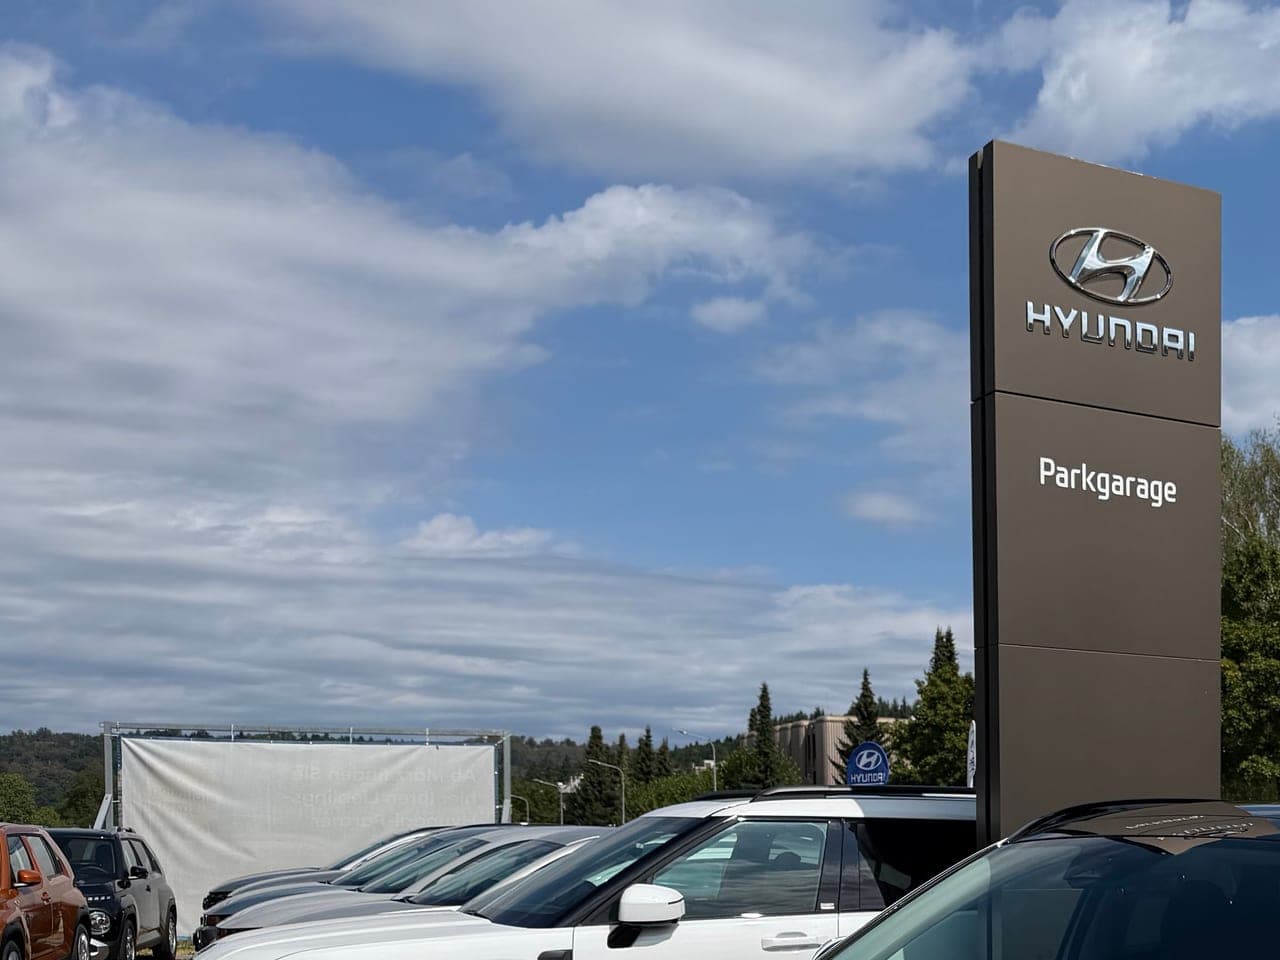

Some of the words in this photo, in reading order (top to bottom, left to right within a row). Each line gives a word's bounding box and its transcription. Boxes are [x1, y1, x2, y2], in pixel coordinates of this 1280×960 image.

[1026, 300, 1195, 361] HYUNDAI
[1039, 456, 1177, 507] Parkgarage
[850, 771, 886, 784] HYUNDAI
